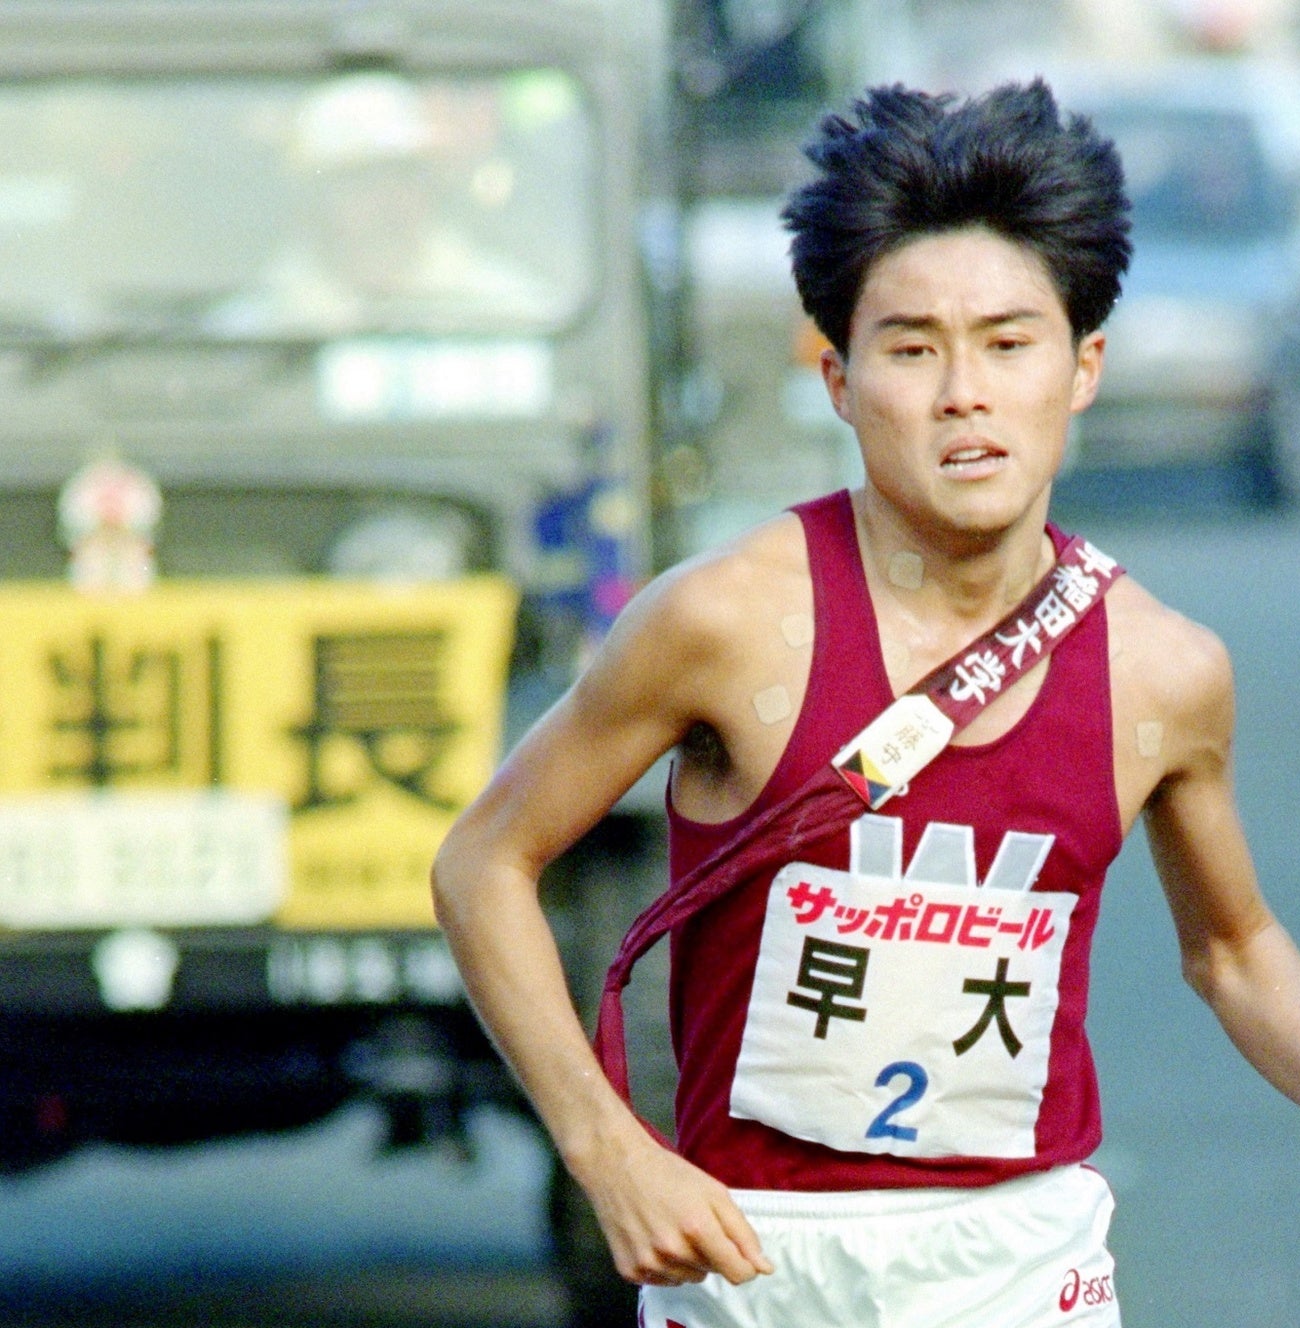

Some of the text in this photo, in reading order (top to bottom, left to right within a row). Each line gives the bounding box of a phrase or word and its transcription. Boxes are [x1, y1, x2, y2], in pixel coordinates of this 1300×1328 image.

[786, 881, 1055, 951] サッポロビール
[865, 1061, 929, 1142] 2
